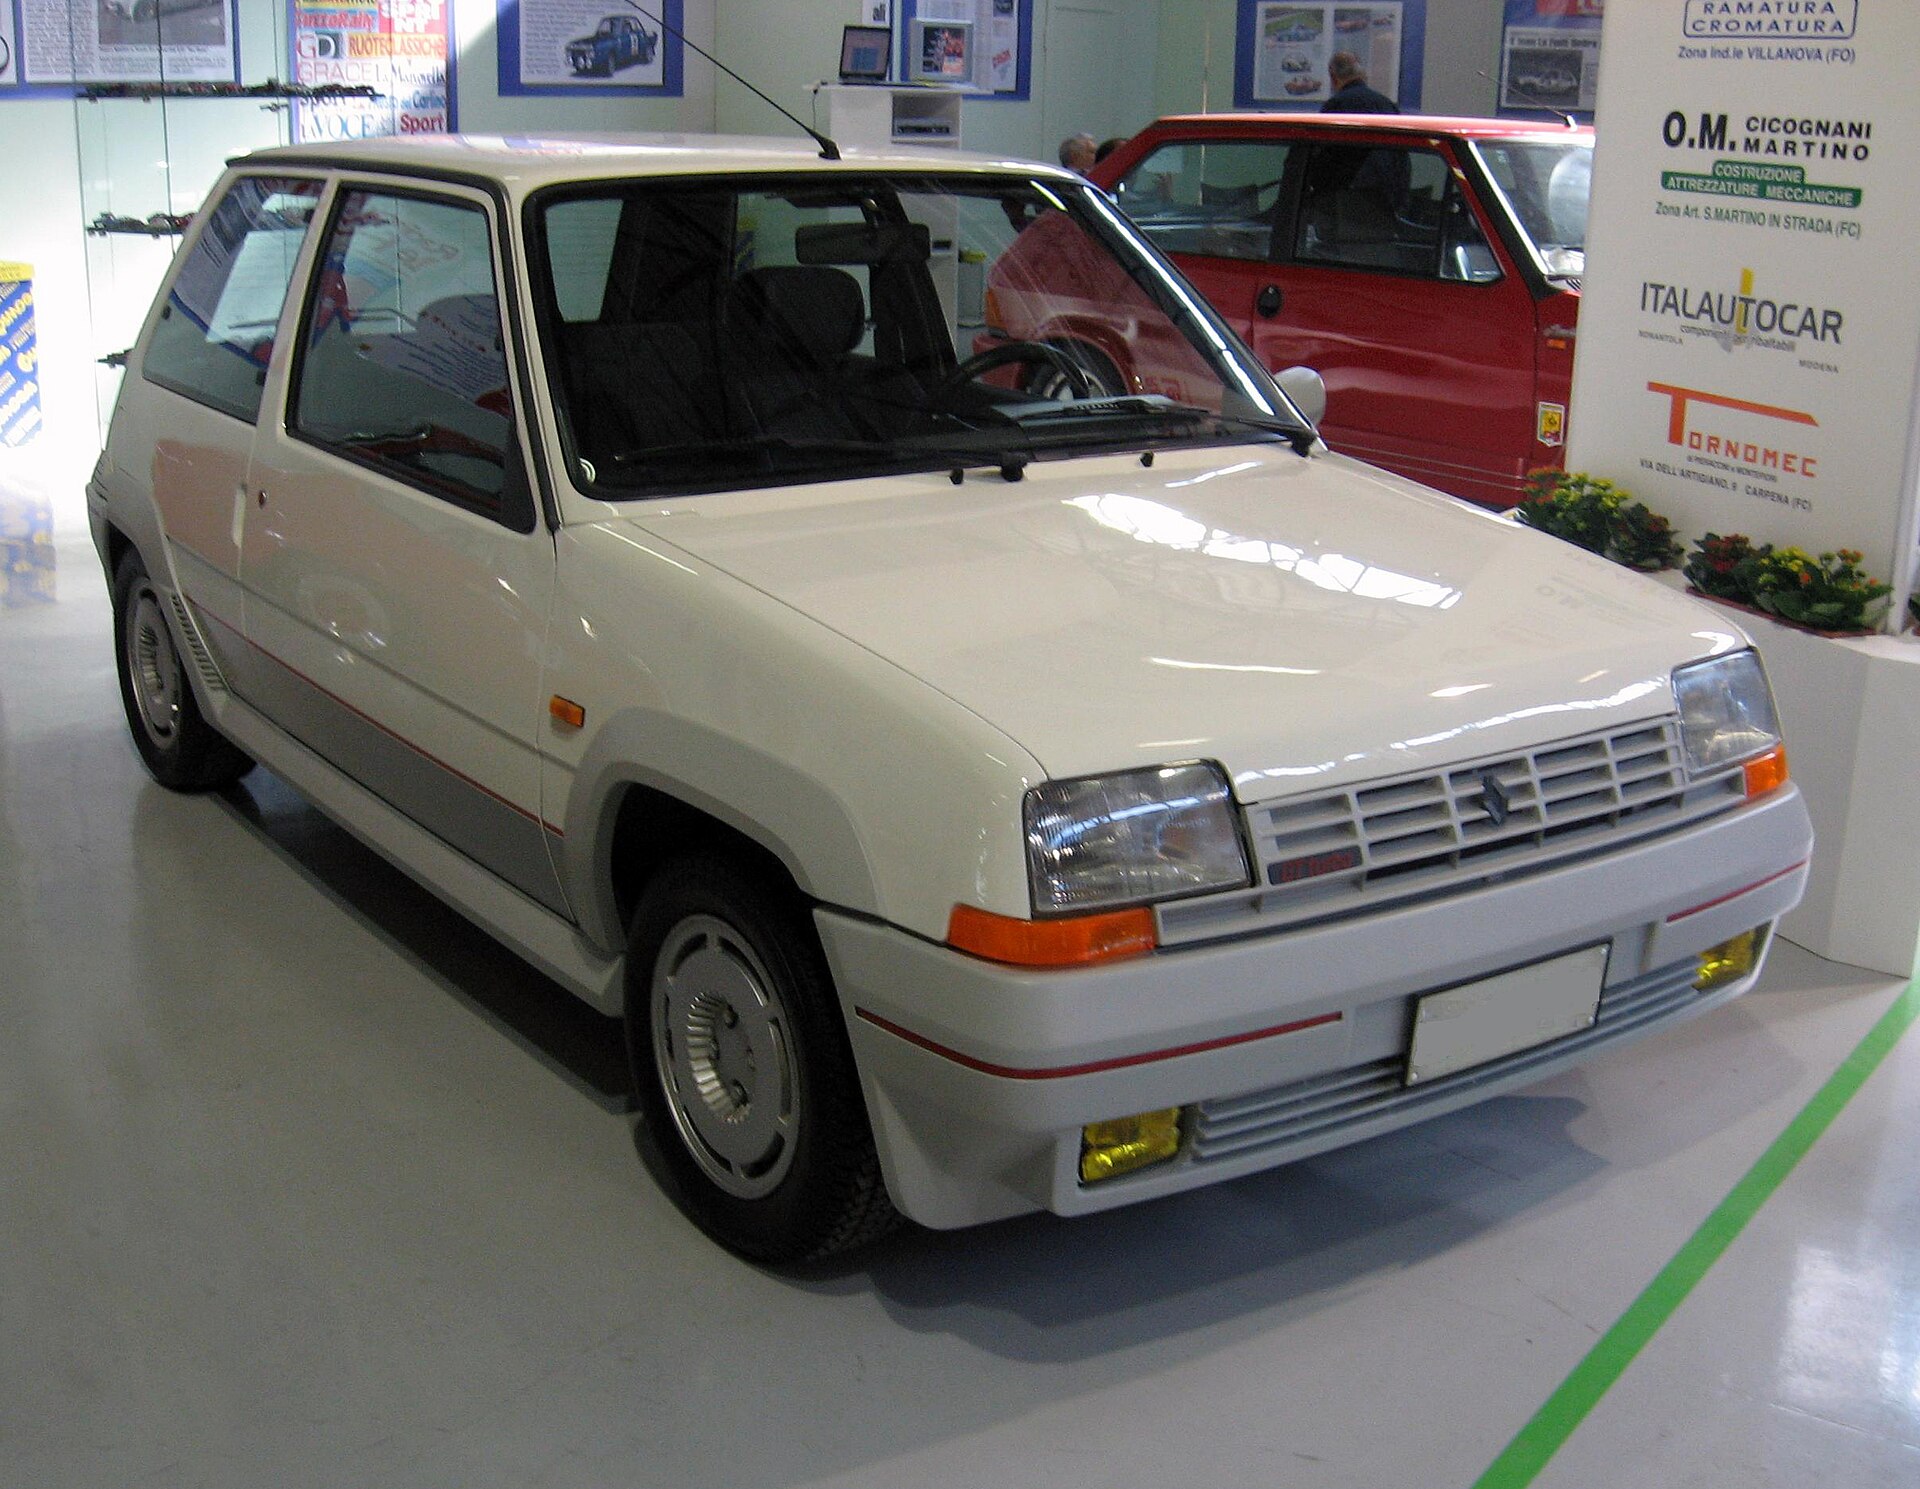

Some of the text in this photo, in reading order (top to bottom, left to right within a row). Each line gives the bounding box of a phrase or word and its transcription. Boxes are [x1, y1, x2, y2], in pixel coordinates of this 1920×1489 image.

[1703, 1, 1836, 14] RAMATURA
[1692, 19, 1844, 33] CROMATURA
[1678, 46, 1707, 59] Zona
[1747, 47, 1822, 61] VILLANOVA
[1826, 48, 1856, 64] (FO)
[400, 113, 444, 134] Sport
[1663, 111, 1736, 151] O.M.
[1746, 116, 1871, 139] CICOGNANI
[1744, 138, 1869, 161] MARTINO
[1715, 164, 1803, 182] COSTRUZIONE
[1668, 176, 1854, 206] ATTREZZATURE MECCANICHE
[1655, 202, 1680, 216] Zona
[1769, 214, 1780, 228] IN
[1784, 216, 1833, 235] STRADA
[1835, 221, 1861, 240] (FC)
[1641, 282, 1843, 345] ITALAUTOCAR
[1799, 359, 1839, 374] MODENA
[1640, 458, 1653, 470] VIA
